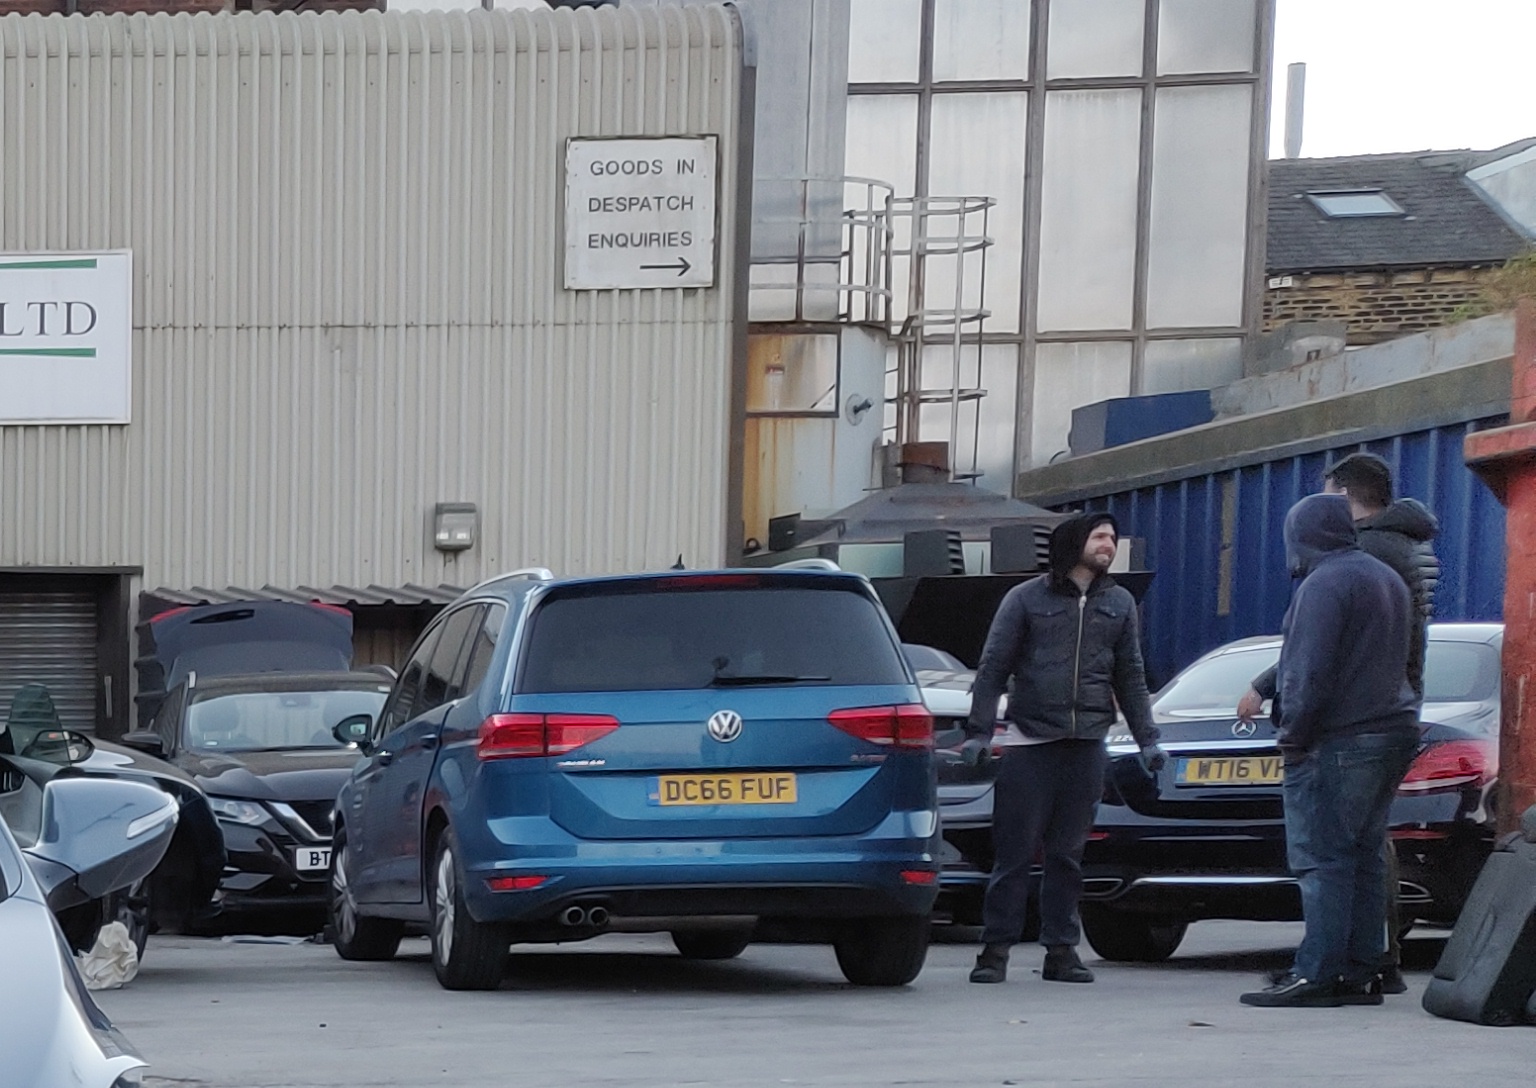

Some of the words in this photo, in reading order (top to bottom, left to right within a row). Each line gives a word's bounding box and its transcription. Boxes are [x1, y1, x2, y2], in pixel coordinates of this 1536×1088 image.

[589, 159, 663, 176] GOODS
[676, 158, 695, 175] IN
[588, 195, 694, 213] DESPATCH
[587, 231, 693, 249] ENQUIRIES
[1197, 759, 1252, 779] WT16
[665, 779, 733, 801] DC66
[740, 777, 791, 800] FUF
